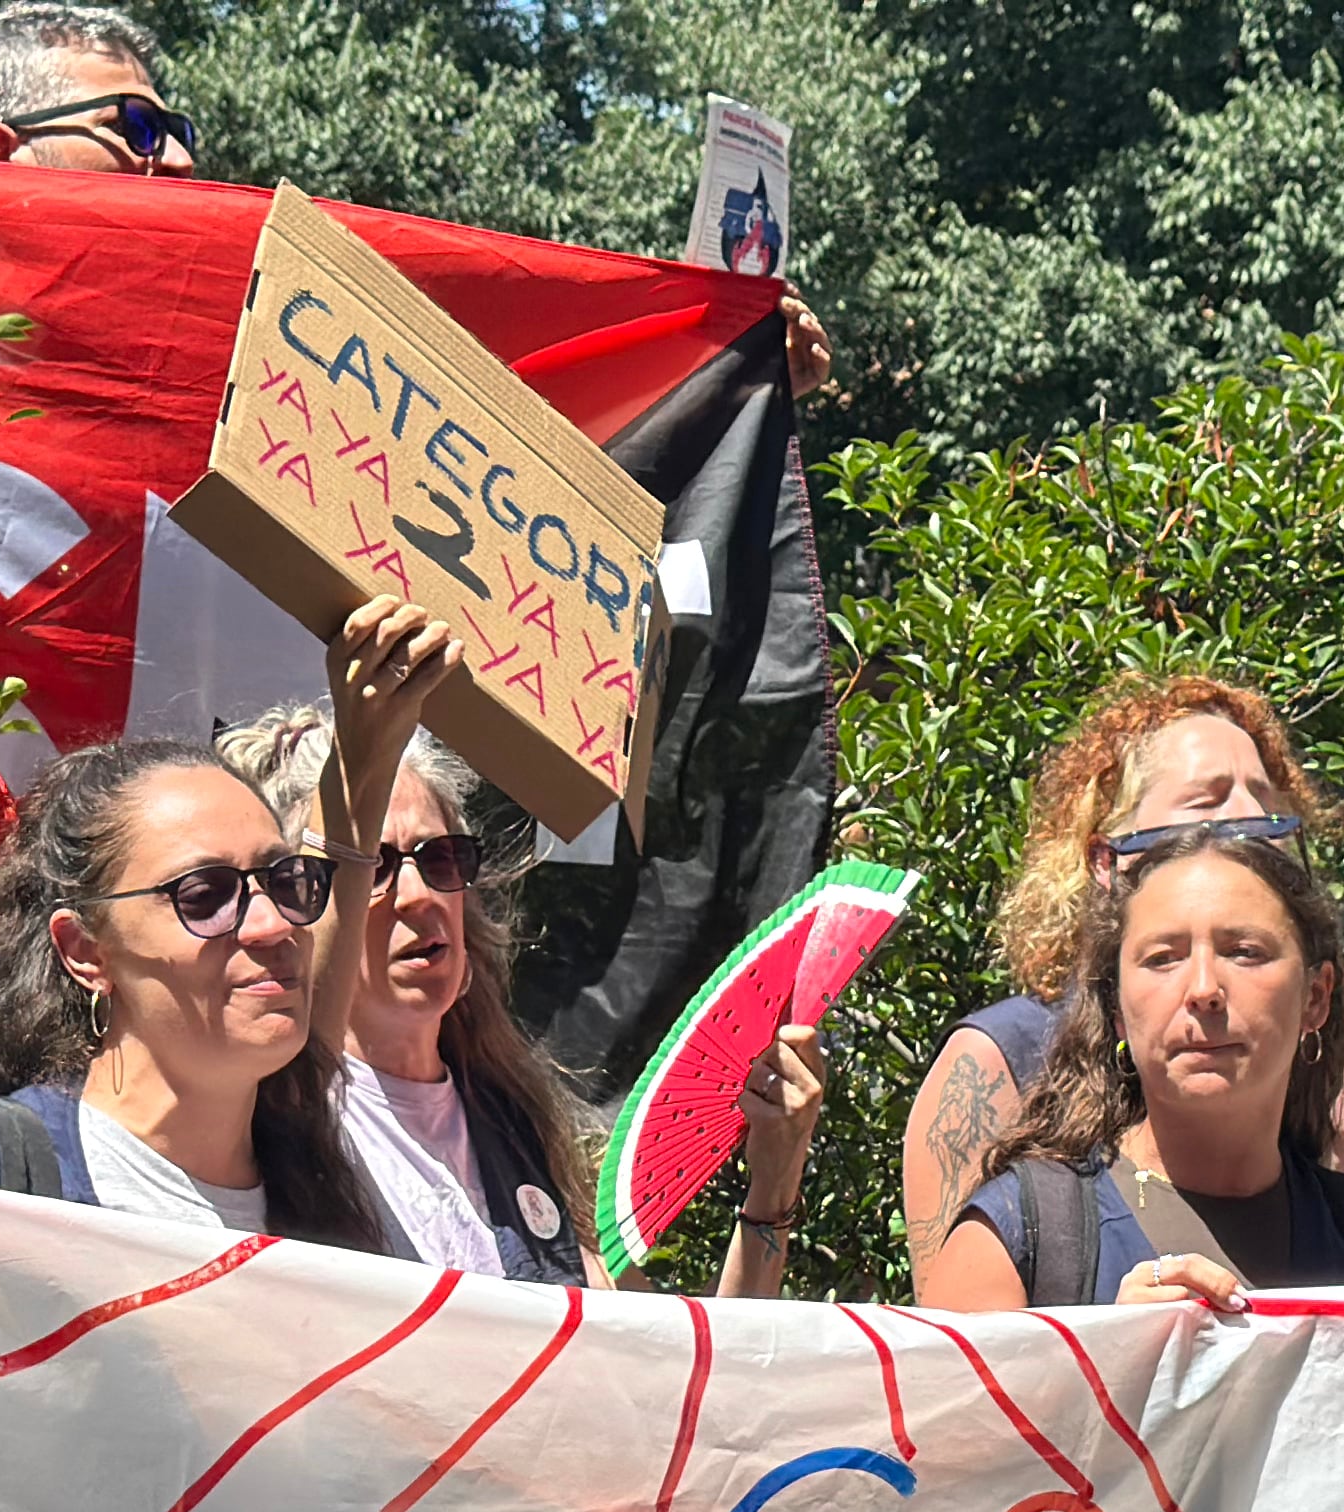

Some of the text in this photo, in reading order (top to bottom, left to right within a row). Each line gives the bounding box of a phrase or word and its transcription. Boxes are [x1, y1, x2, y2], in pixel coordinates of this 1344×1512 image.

[256, 417, 619, 790] YA YA YA YA
[260, 358, 638, 713] YA YA 2 YA YA
